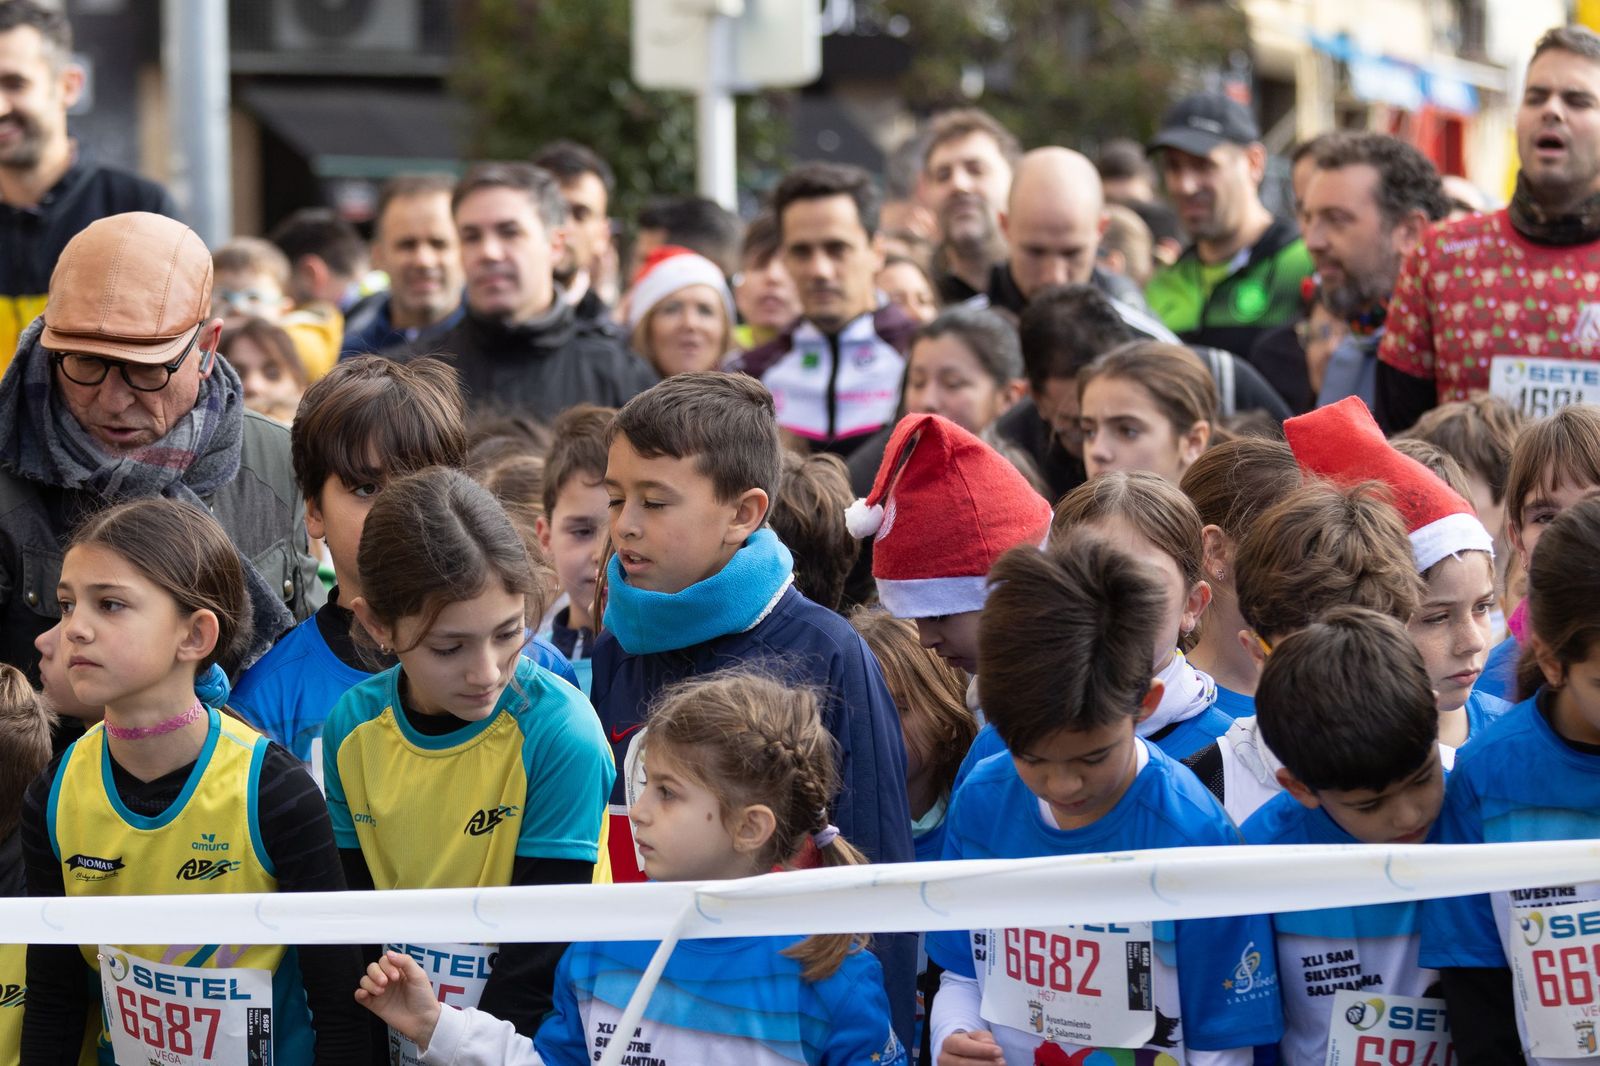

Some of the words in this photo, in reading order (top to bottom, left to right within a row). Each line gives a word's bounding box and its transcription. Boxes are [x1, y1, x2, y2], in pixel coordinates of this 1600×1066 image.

[192, 841, 229, 851] amura
[1004, 927, 1102, 997] 6682
[1301, 955, 1323, 968] XLI
[1326, 949, 1354, 964] SAN
[132, 964, 251, 1000] SETEL
[116, 985, 221, 1060] 6587
[154, 1048, 182, 1065] VEGA
